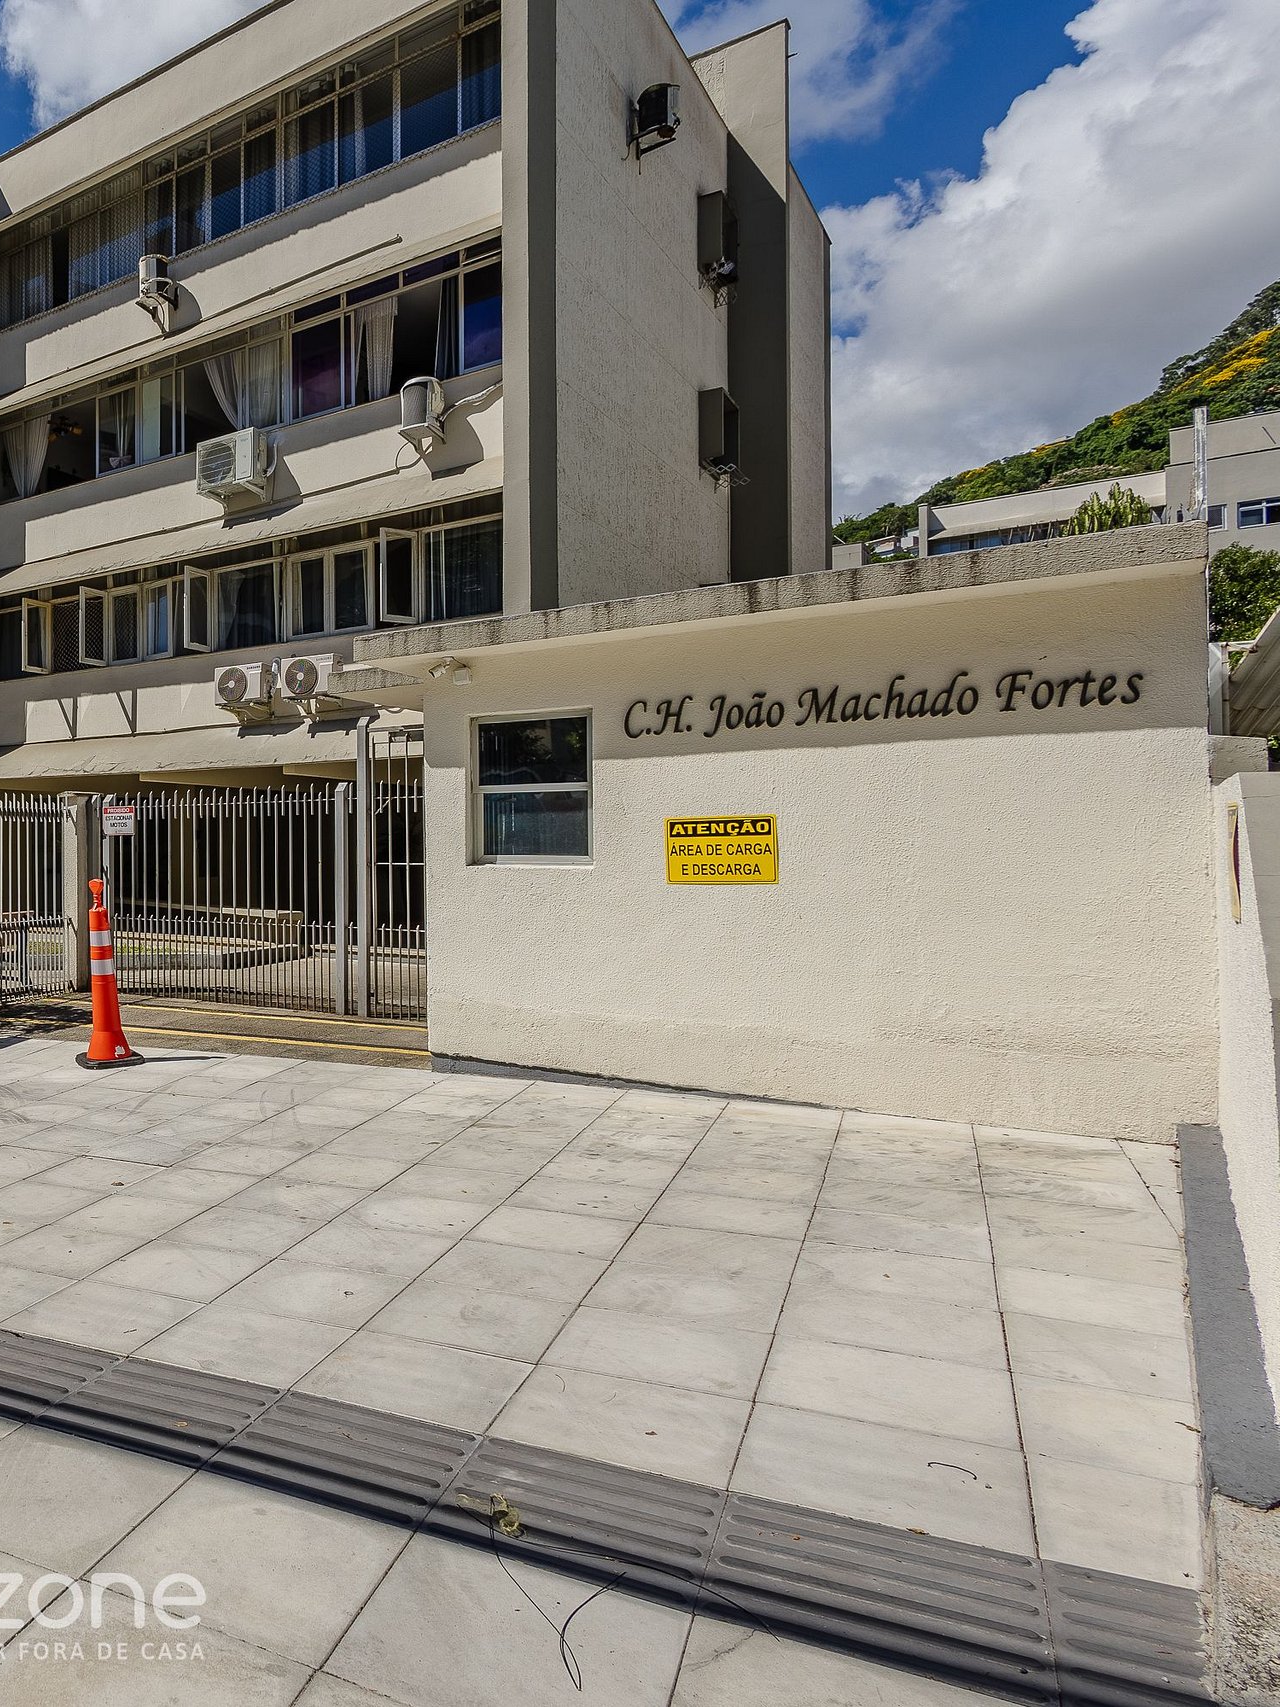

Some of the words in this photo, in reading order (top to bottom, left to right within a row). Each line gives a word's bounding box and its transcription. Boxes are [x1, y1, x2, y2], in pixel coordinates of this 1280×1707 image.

[623, 695, 694, 739] C.H.
[703, 692, 785, 738] João
[794, 671, 979, 727] Machado
[995, 669, 1144, 713] Fortes
[671, 819, 770, 836] ATENÇÃO
[669, 842, 704, 857] ÁREA
[706, 844, 723, 856] DE
[726, 843, 773, 856] CARGA
[681, 864, 689, 876] E
[692, 863, 762, 876] DESCARGA
